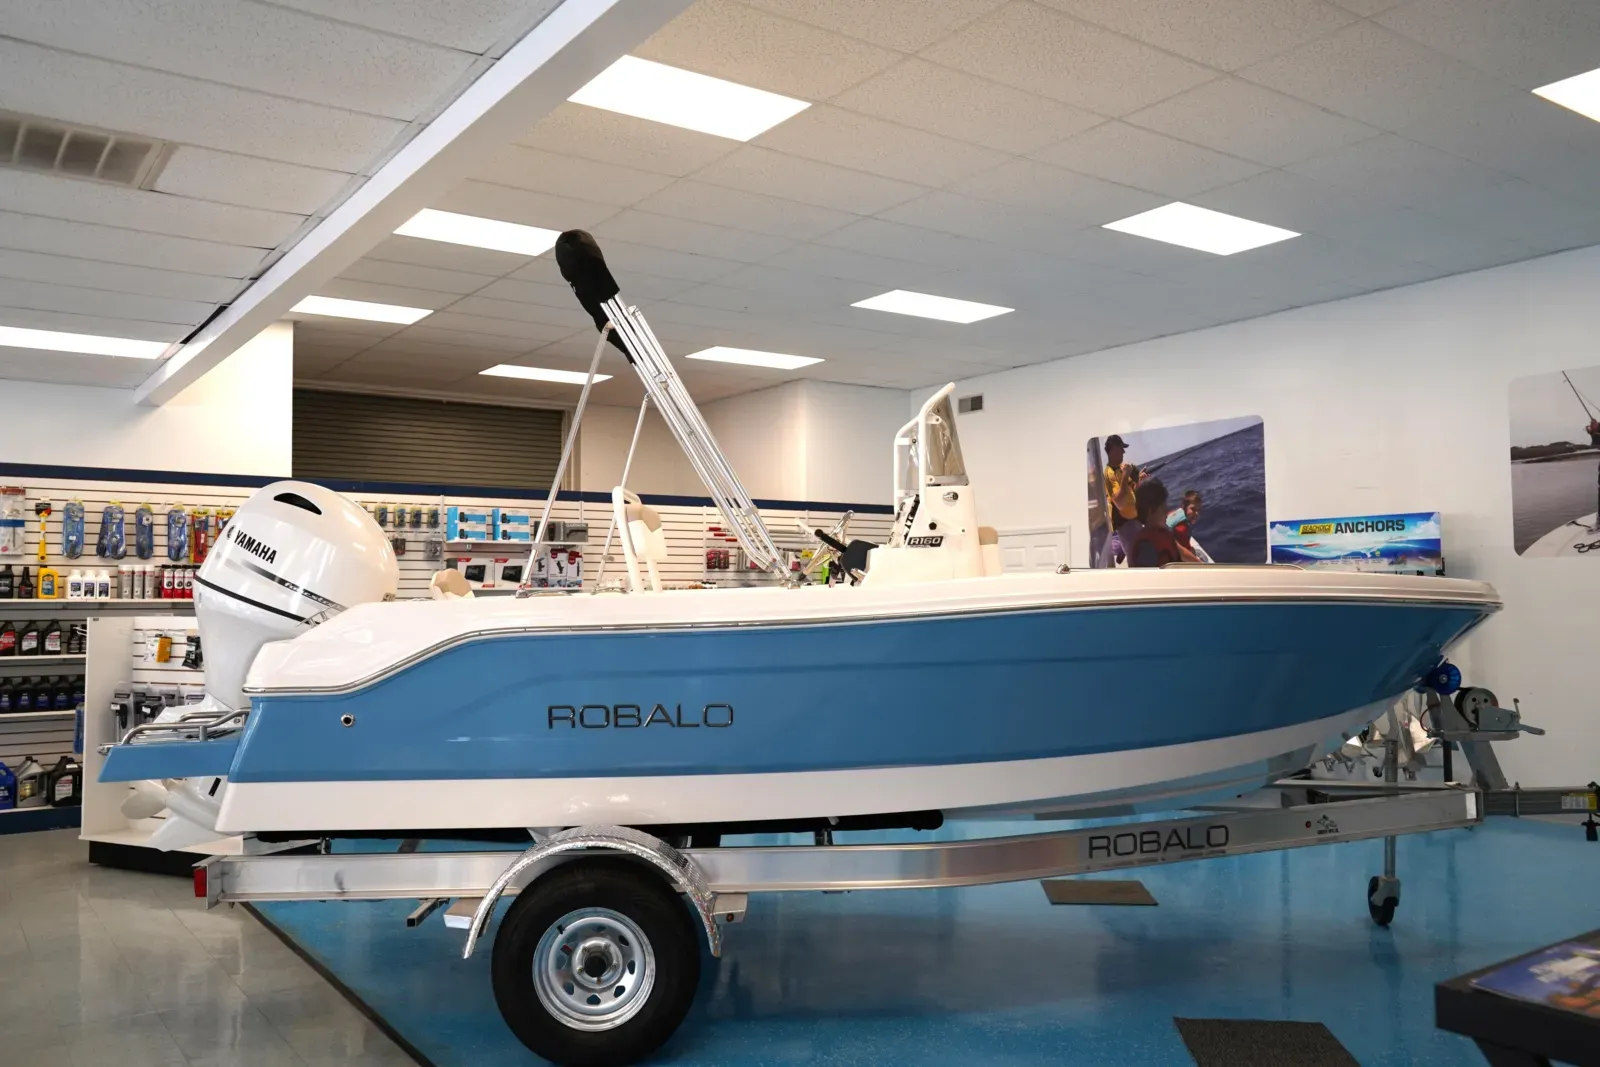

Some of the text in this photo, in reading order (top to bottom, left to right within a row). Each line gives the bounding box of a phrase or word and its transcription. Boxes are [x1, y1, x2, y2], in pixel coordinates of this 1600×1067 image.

[1334, 519, 1406, 534] ANCHORS
[234, 530, 277, 564] YAMAHA
[910, 536, 941, 545] R160
[547, 703, 734, 729] ROBALO
[1088, 825, 1230, 859] ROBALO
